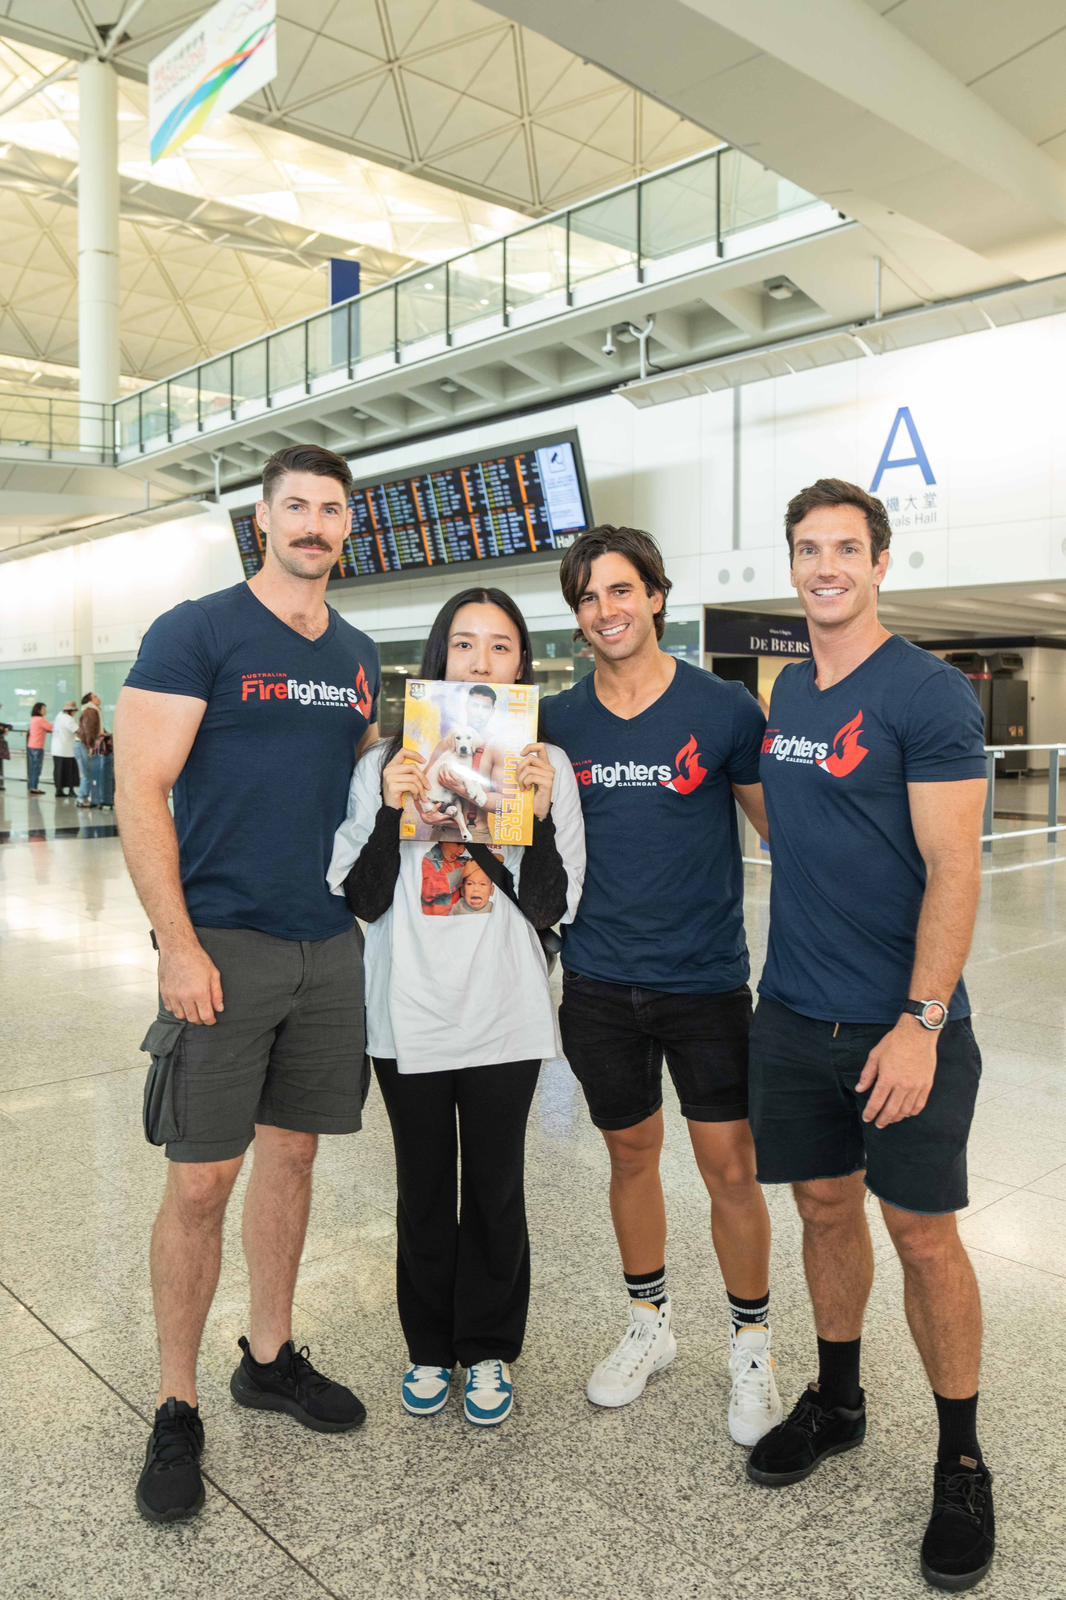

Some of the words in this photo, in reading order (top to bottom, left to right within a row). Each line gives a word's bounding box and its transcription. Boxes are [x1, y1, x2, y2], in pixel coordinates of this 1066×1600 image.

[869, 406, 937, 492] A
[886, 492, 937, 512] 機大堂
[914, 511, 937, 525] Hall
[750, 636, 769, 651] DE
[771, 637, 810, 653] BEERS
[241, 672, 288, 680] AUSTRALIAN
[241, 679, 358, 706] Firefighters
[312, 700, 349, 708] CALENDAR
[785, 756, 814, 765] CALENDAR
[575, 761, 672, 788] refighters
